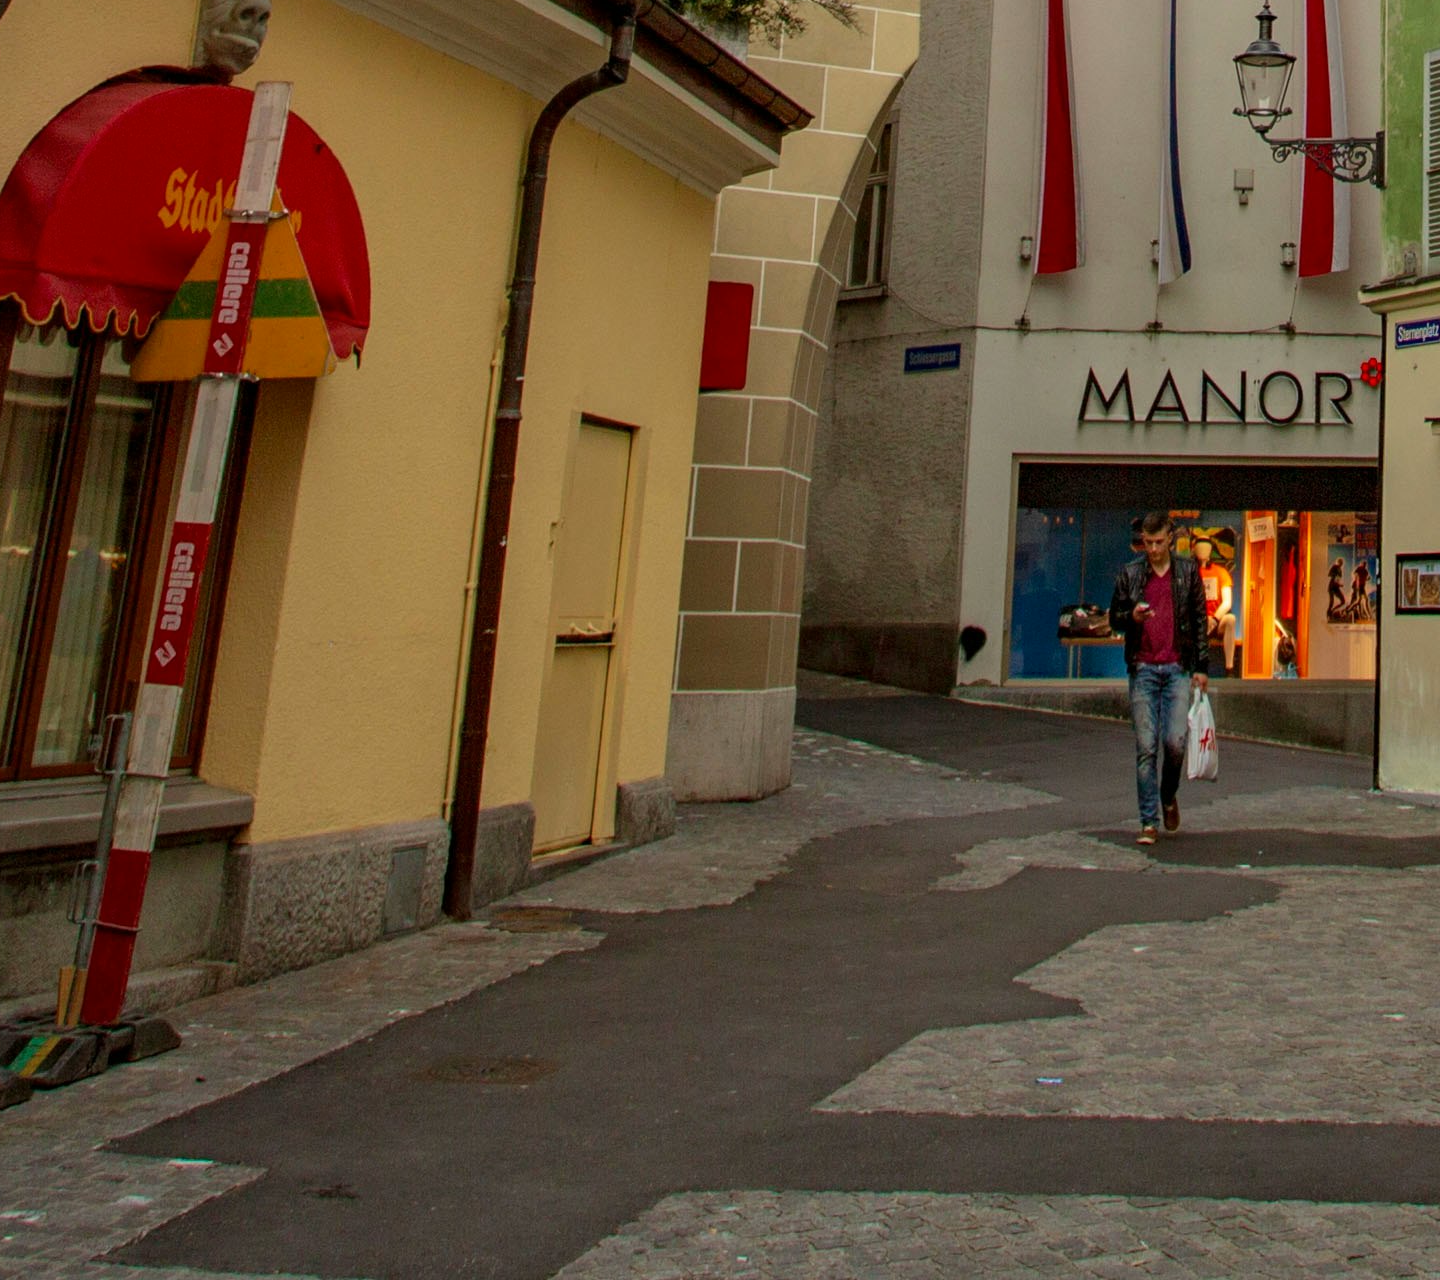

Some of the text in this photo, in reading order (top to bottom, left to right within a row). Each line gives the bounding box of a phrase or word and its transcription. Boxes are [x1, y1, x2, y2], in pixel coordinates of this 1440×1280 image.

[218, 242, 250, 324] cellere
[1078, 367, 1353, 425] MANOR
[160, 542, 195, 631] cellere
